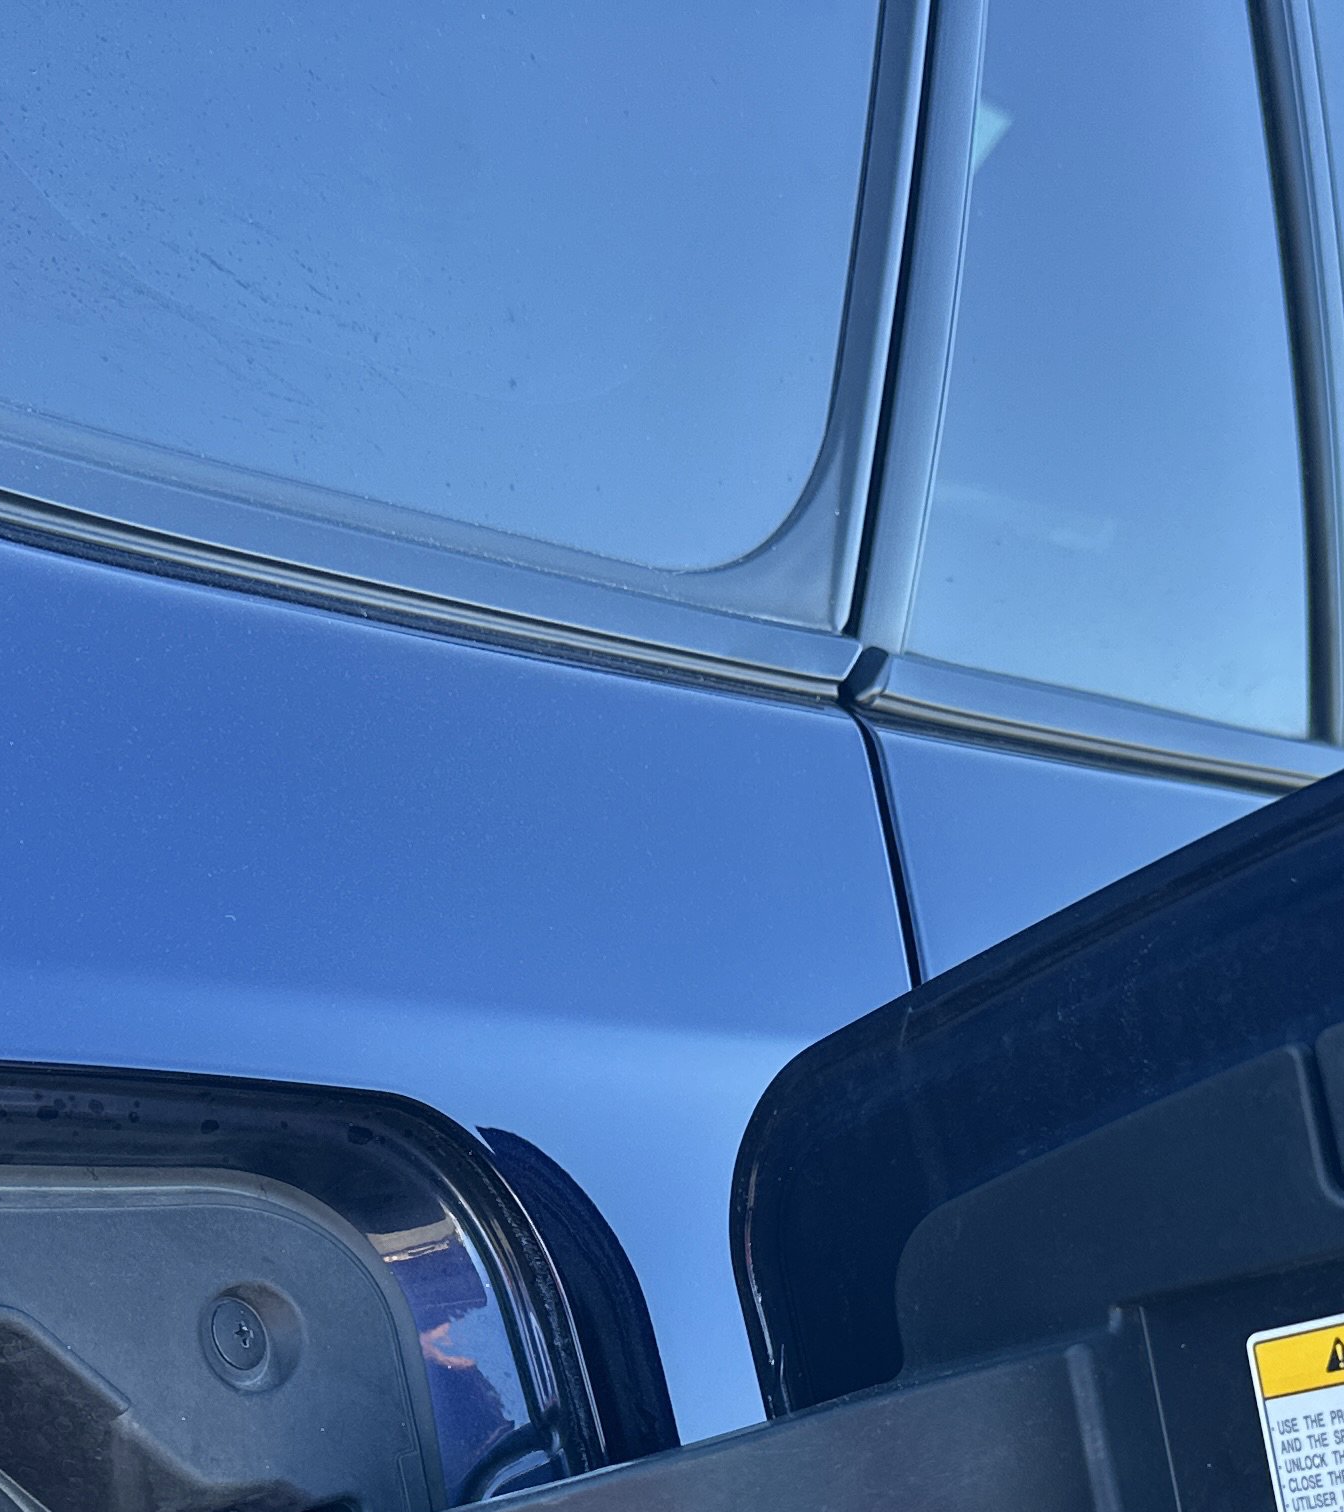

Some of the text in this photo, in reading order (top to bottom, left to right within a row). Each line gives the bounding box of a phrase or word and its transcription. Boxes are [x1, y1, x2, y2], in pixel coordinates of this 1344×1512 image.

[1277, 1417, 1299, 1435] USE
[1303, 1412, 1325, 1430] THE
[1281, 1438, 1302, 1455] AND
[1306, 1432, 1329, 1450] THE
[1284, 1453, 1328, 1473] UNLOCK
[1288, 1473, 1323, 1493] CLOSE
[1292, 1491, 1337, 1512] UTILISER
